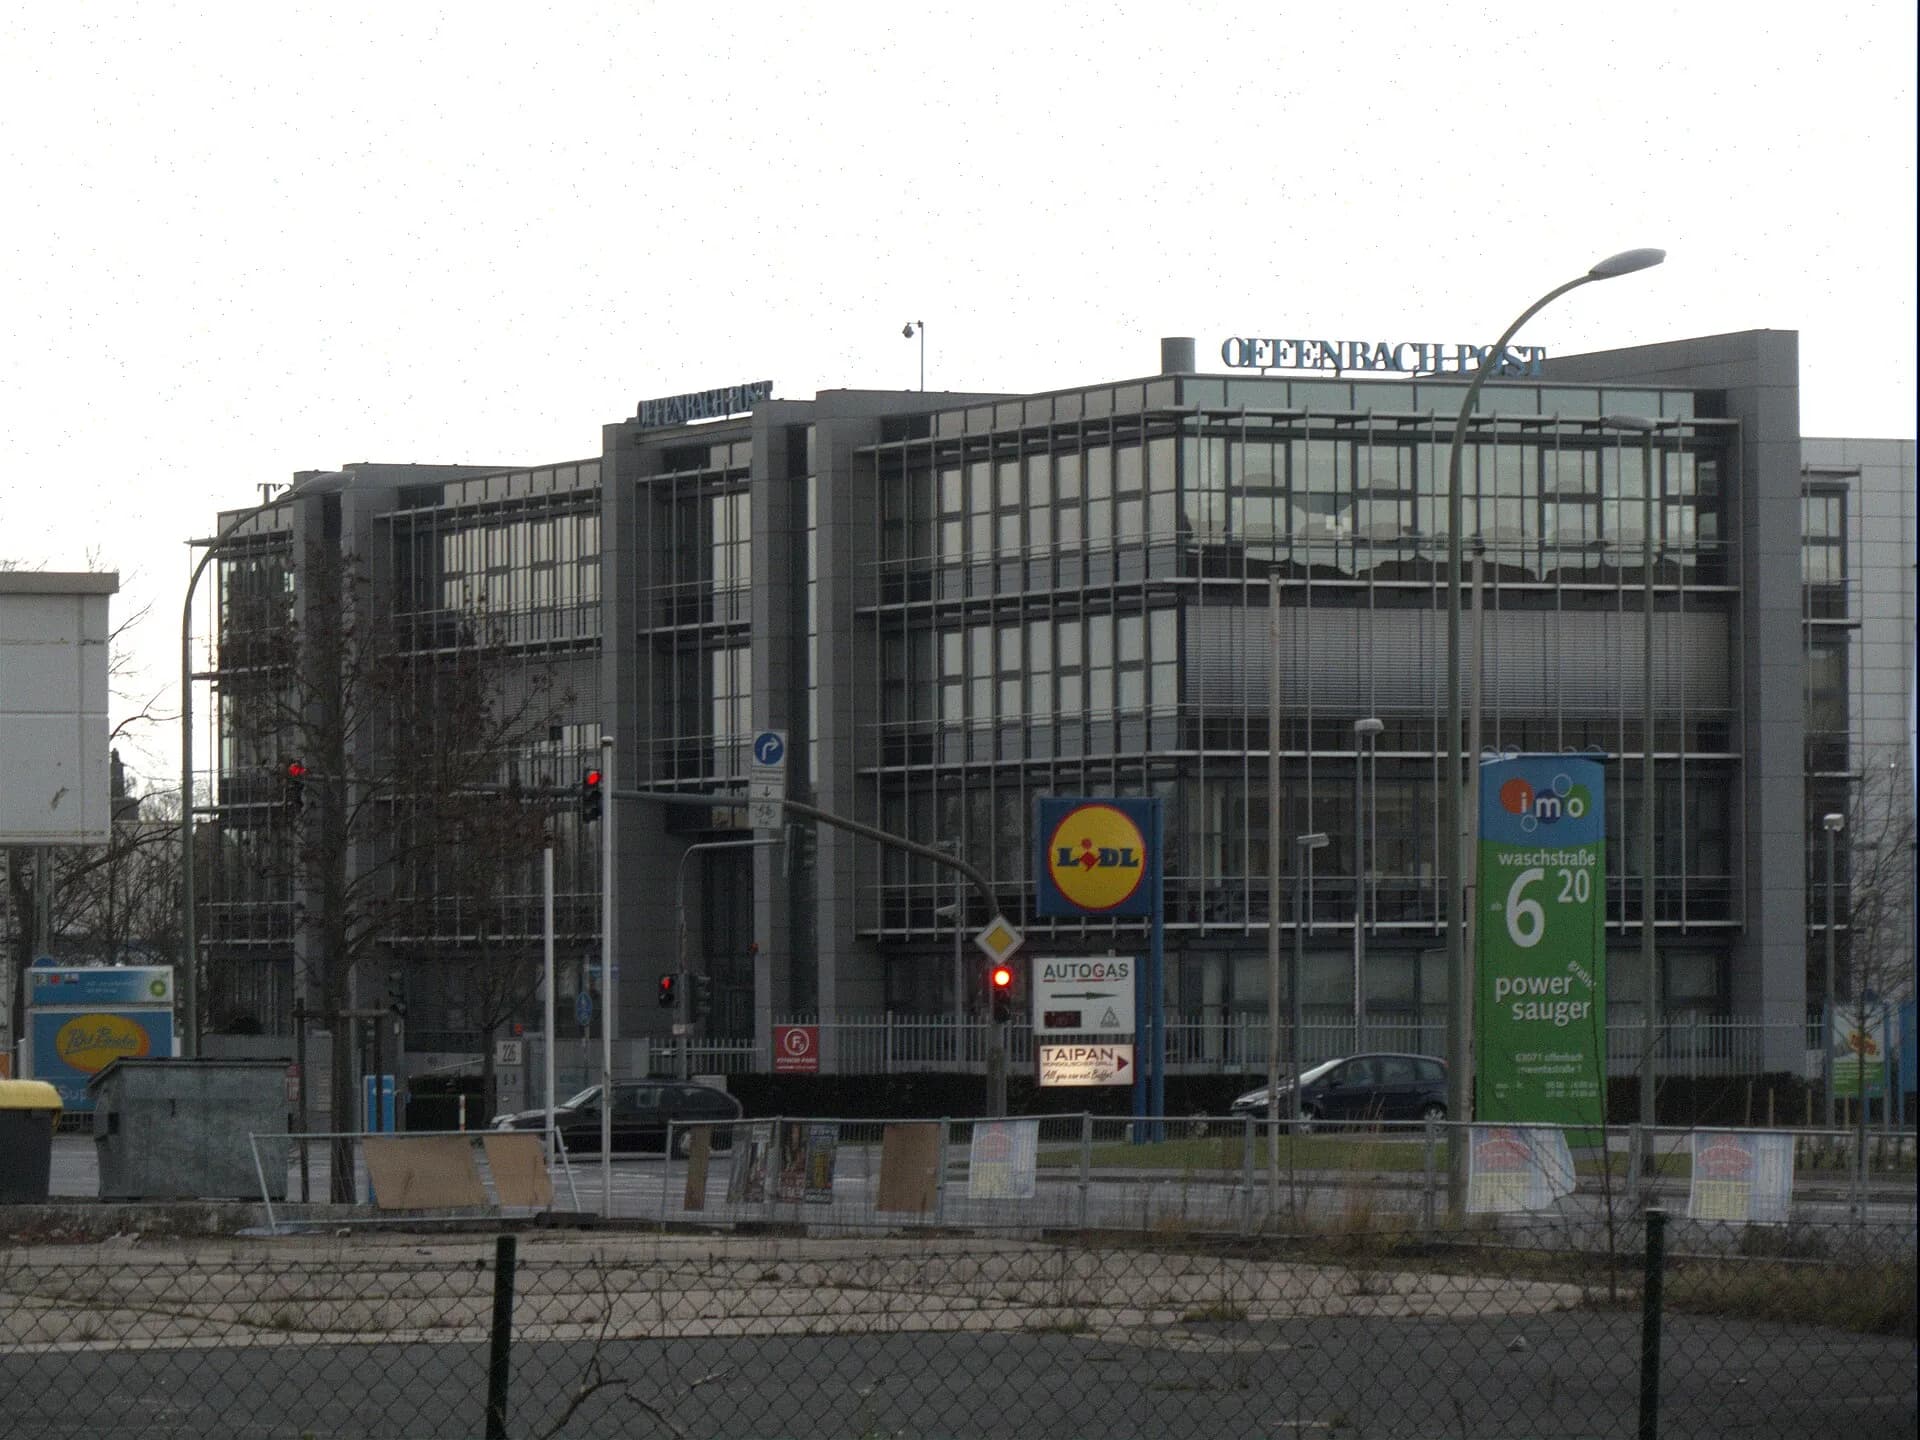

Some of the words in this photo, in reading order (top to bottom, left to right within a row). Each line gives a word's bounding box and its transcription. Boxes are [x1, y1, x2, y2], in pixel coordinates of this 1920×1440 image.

[1221, 336, 1546, 376] OFFENBACH-POST
[1519, 791, 1584, 817] imo
[1498, 848, 1596, 867] waschstraße
[1506, 868, 1545, 948] 6
[1557, 868, 1590, 904] 20
[1043, 963, 1129, 979] AUTOGAS
[1495, 975, 1573, 1003] power
[1511, 1000, 1593, 1027] sauger
[1042, 1047, 1114, 1061] TAIPAN
